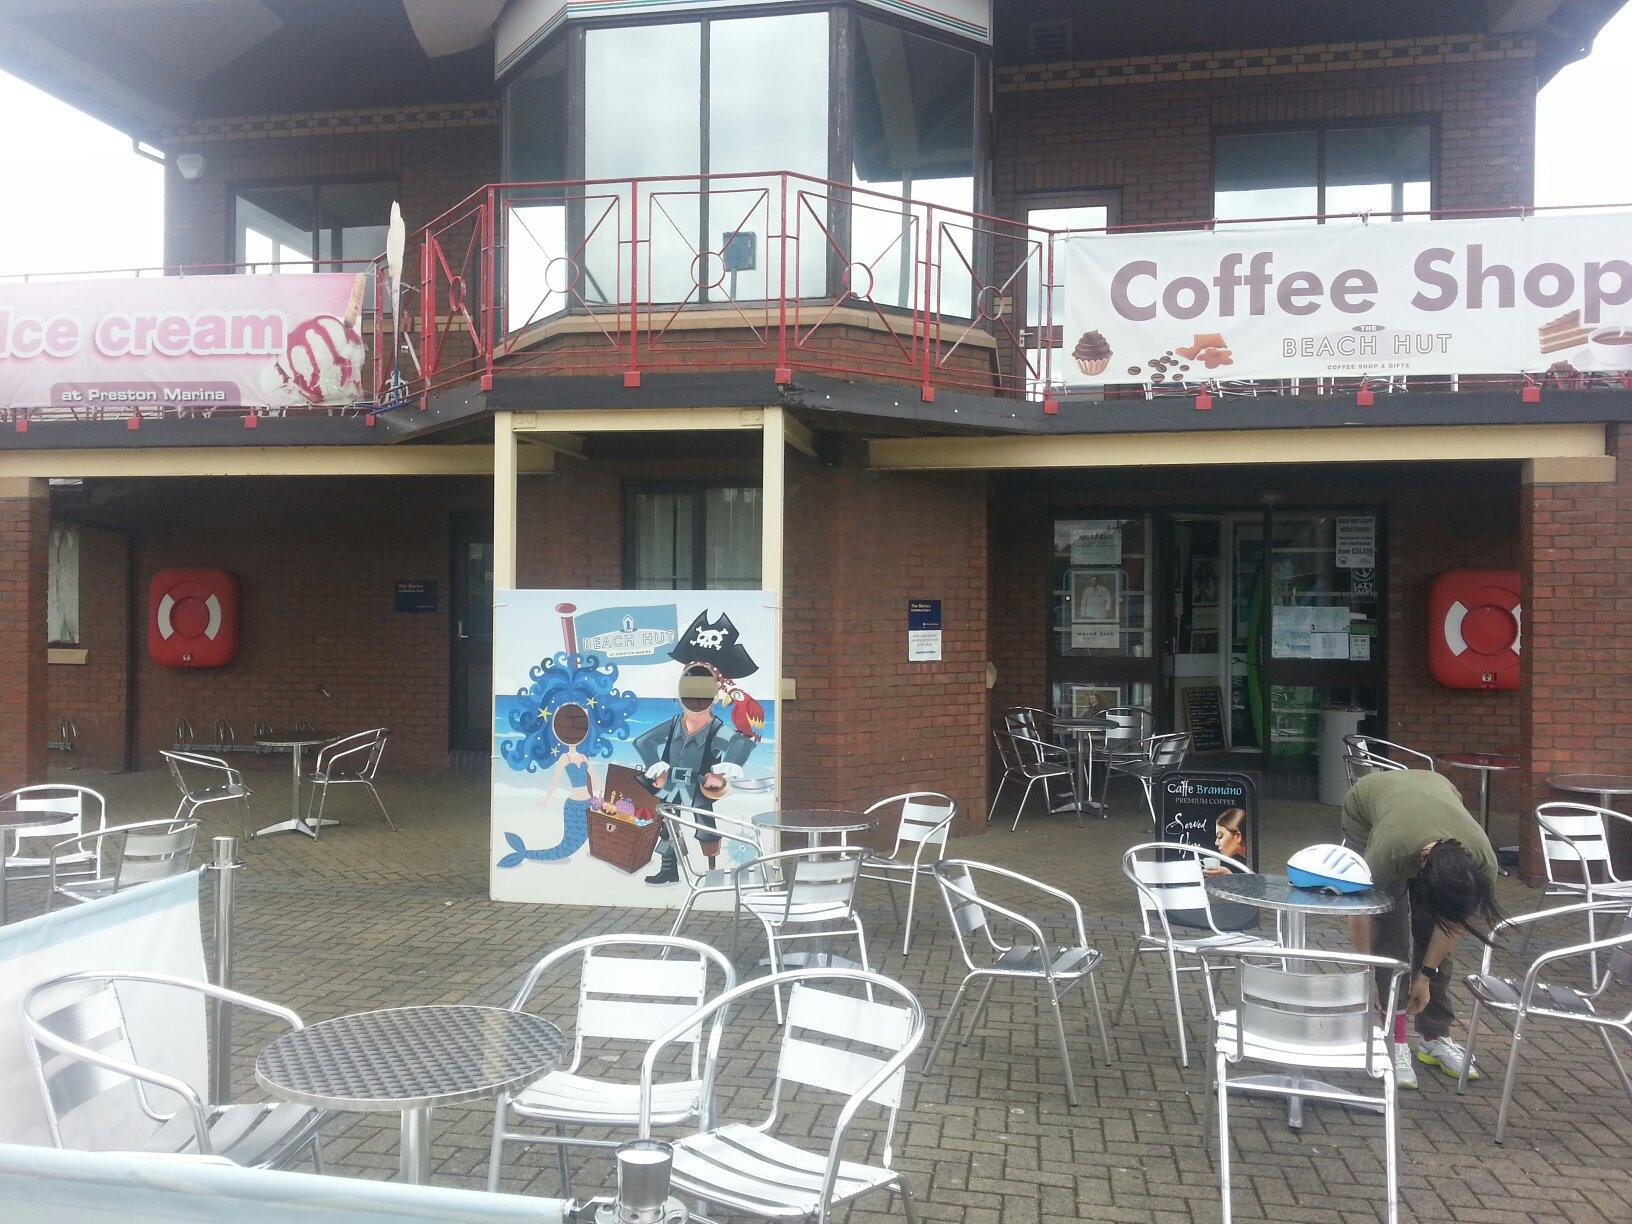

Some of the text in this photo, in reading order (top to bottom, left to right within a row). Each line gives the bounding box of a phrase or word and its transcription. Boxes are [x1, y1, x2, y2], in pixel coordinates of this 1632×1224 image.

[1110, 244, 1632, 323] Coffee Shop
[99, 313, 284, 351] cream
[1282, 333, 1452, 358] BEACH HUT
[61, 389, 226, 401] at Preston Marina
[584, 631, 675, 651] BEACH HUT
[1167, 781, 1242, 797] Caffe Bramano
[1175, 797, 1208, 805] PREMIUM
[1165, 812, 1207, 835] Served
